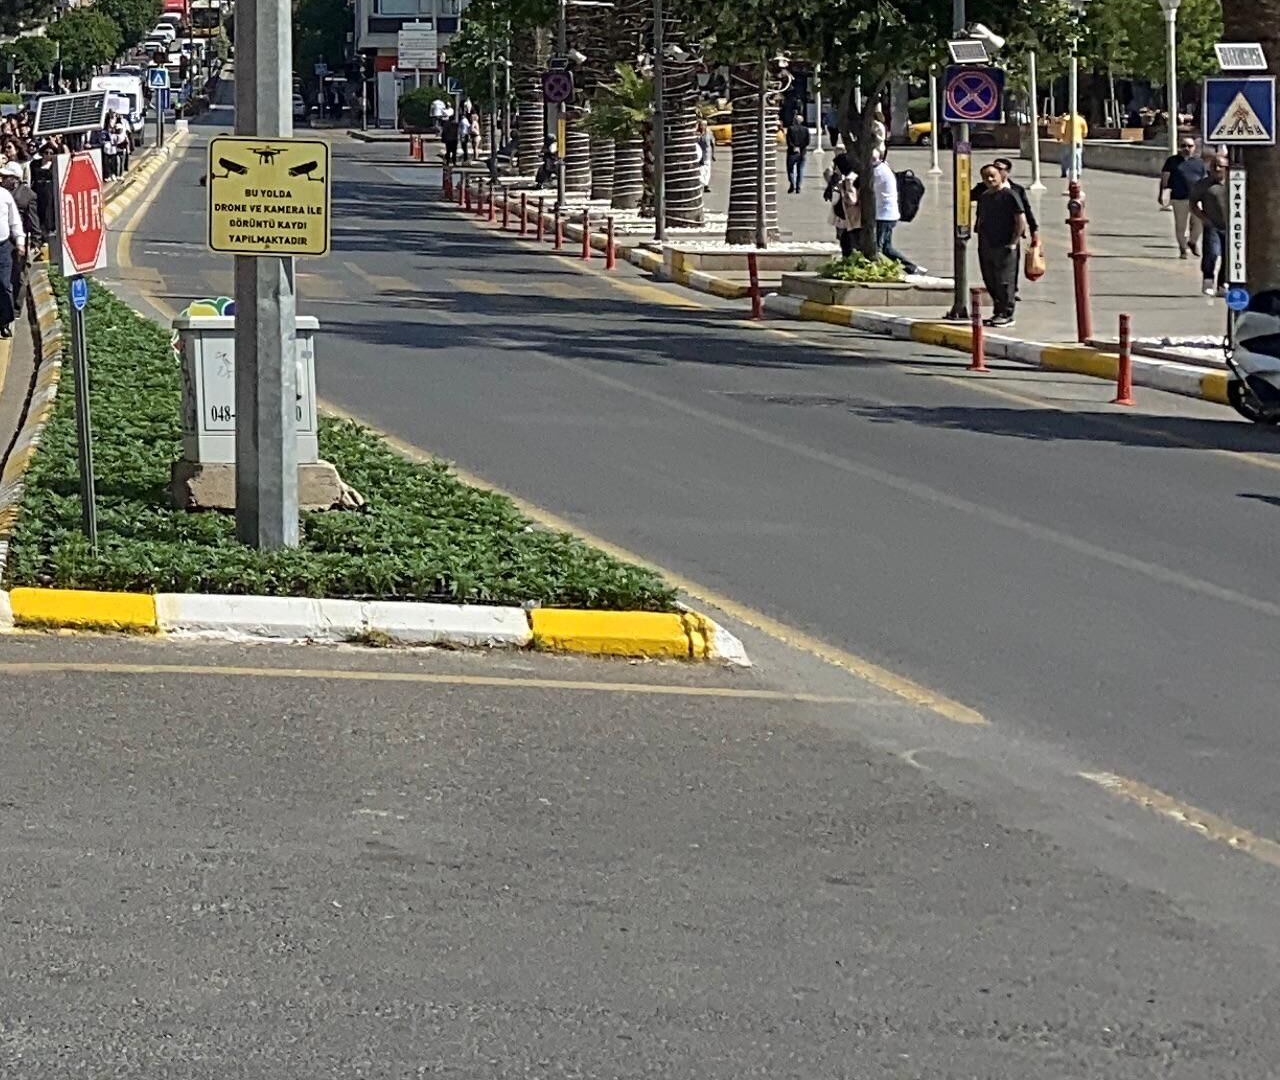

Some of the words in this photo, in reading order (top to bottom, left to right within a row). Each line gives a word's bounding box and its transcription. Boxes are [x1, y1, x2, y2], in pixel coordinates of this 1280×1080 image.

[245, 189, 258, 197] BU
[261, 190, 292, 198] YOLDA
[65, 188, 101, 236] DUR
[215, 204, 247, 212] DRONE
[250, 205, 262, 213] VE
[264, 205, 305, 214] KAMERA
[307, 206, 322, 215] İLE
[229, 218, 275, 229] GÖRÜNTÜ
[278, 221, 307, 229] KAYDI
[229, 235, 307, 245] YAPILMAKTADIR
[211, 405, 236, 422] 048-
